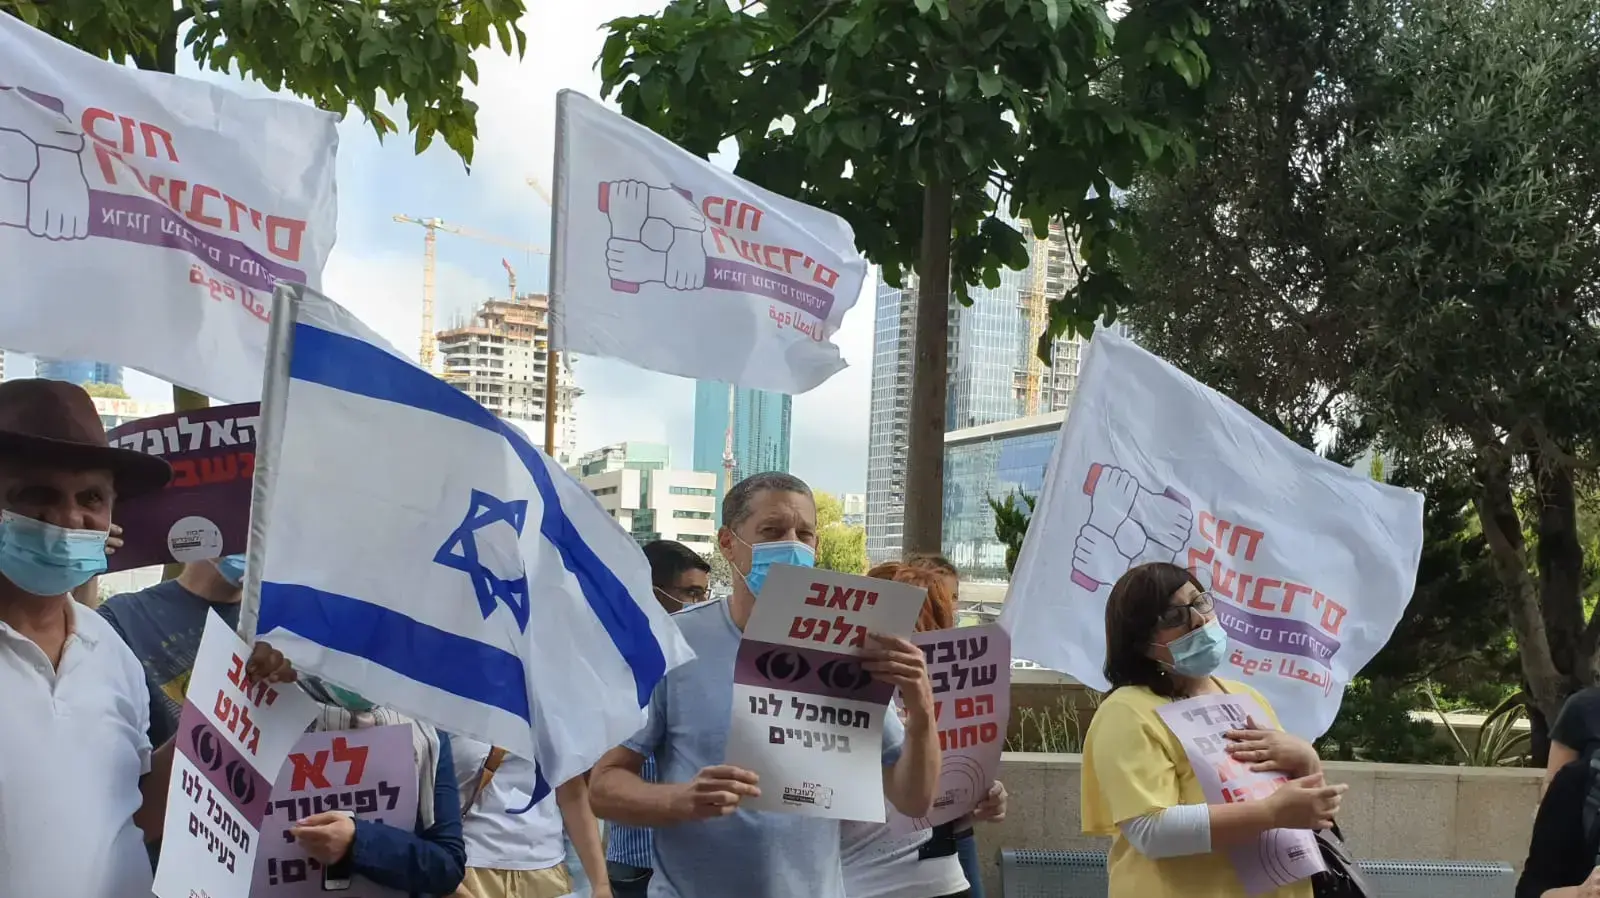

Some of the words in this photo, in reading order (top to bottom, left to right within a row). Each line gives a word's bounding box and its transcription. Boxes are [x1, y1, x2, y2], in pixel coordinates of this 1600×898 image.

[805, 582, 879, 612] יואב
[788, 616, 868, 648] גלנט
[749, 693, 783, 716] לנו
[792, 696, 870, 729] תסתכל
[955, 694, 994, 720] הם
[213, 689, 261, 756] גלנט
[769, 725, 851, 753] בעיניים
[288, 737, 369, 791] לא
[182, 769, 203, 803] לנו
[206, 789, 250, 854] תסתכל
[188, 811, 236, 874] בעיניים
